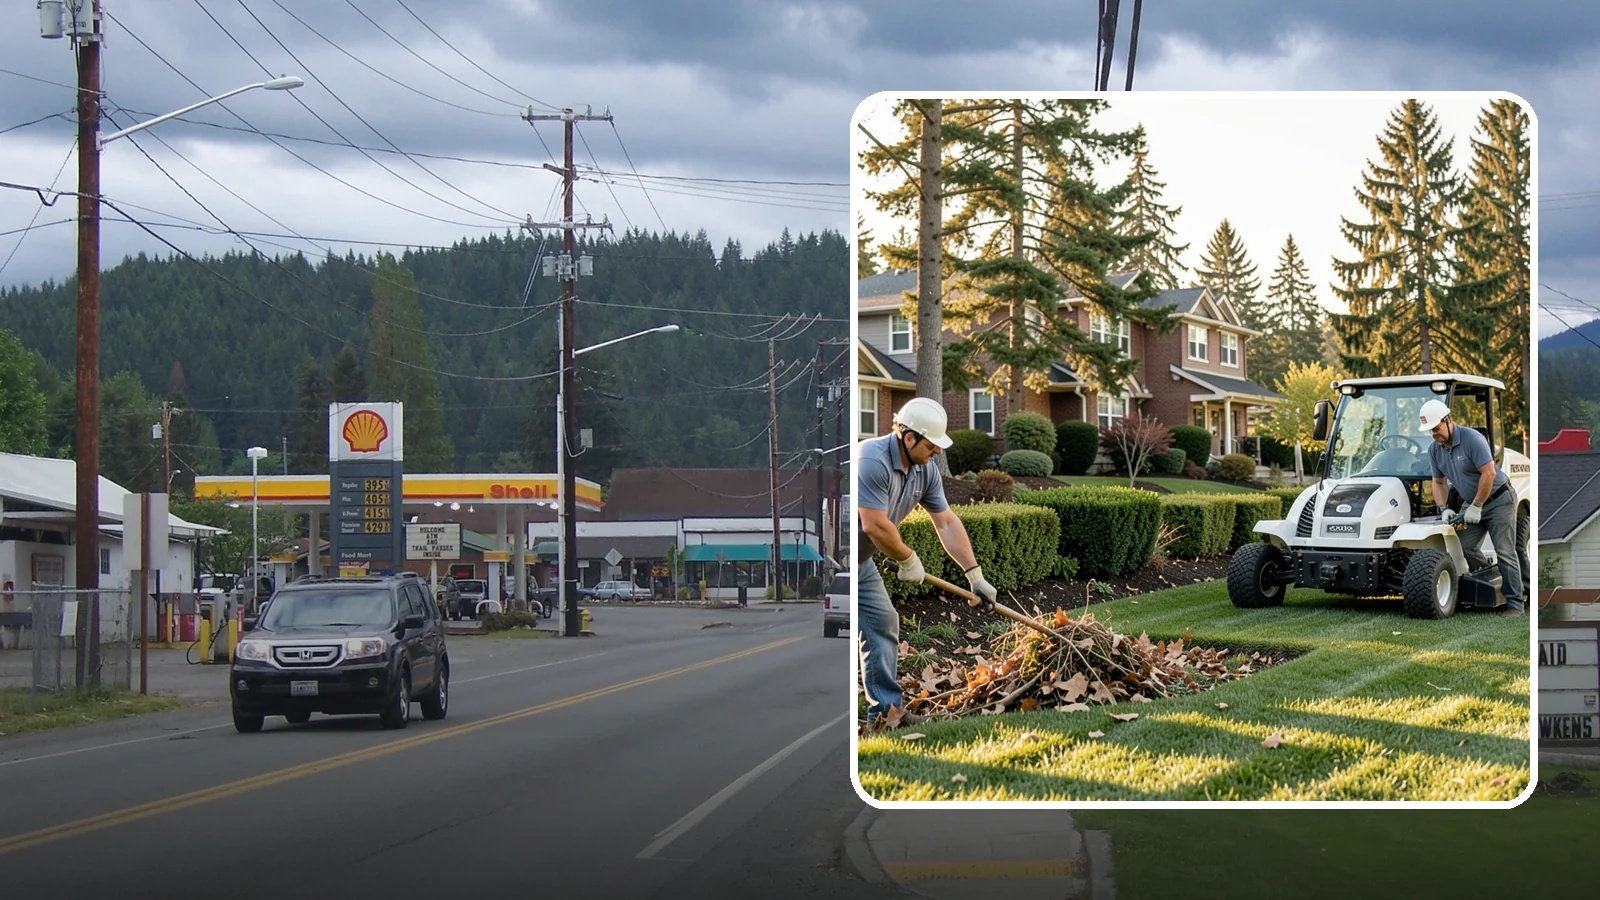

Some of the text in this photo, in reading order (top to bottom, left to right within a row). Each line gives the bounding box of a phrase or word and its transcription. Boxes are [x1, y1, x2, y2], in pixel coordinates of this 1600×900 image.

[366, 480, 383, 490] 395
[490, 484, 547, 499] Shell
[366, 494, 383, 504] 405
[366, 508, 383, 518] 415
[366, 522, 383, 533] 429
